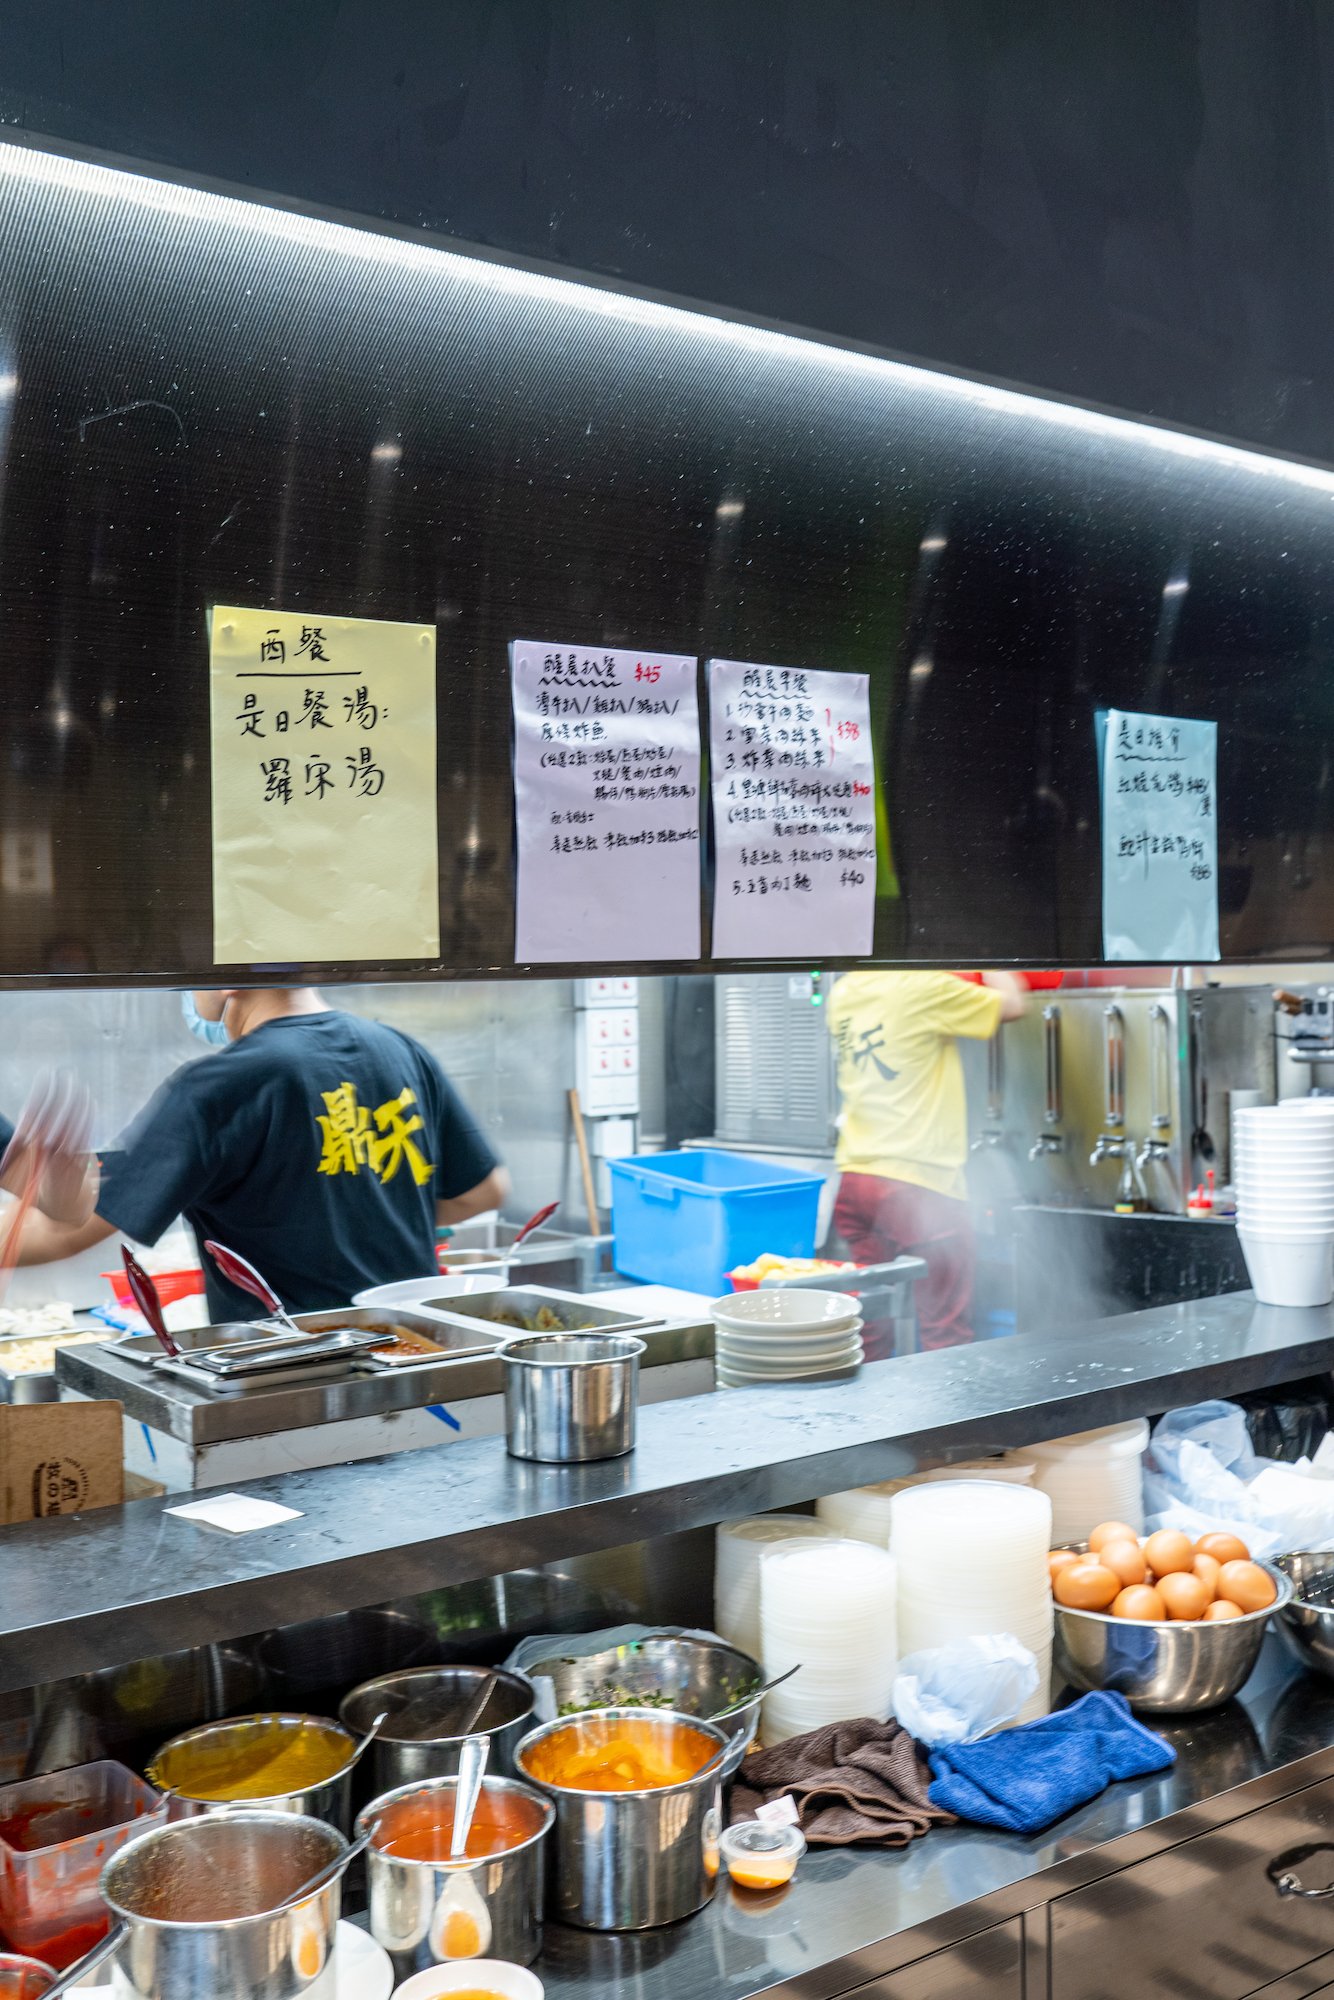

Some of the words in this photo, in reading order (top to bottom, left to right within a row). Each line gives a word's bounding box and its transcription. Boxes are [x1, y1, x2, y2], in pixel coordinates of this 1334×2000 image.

[260, 625, 331, 665] 西餐
[634, 661, 663, 684] $45
[260, 746, 385, 806] 羅宋湯
